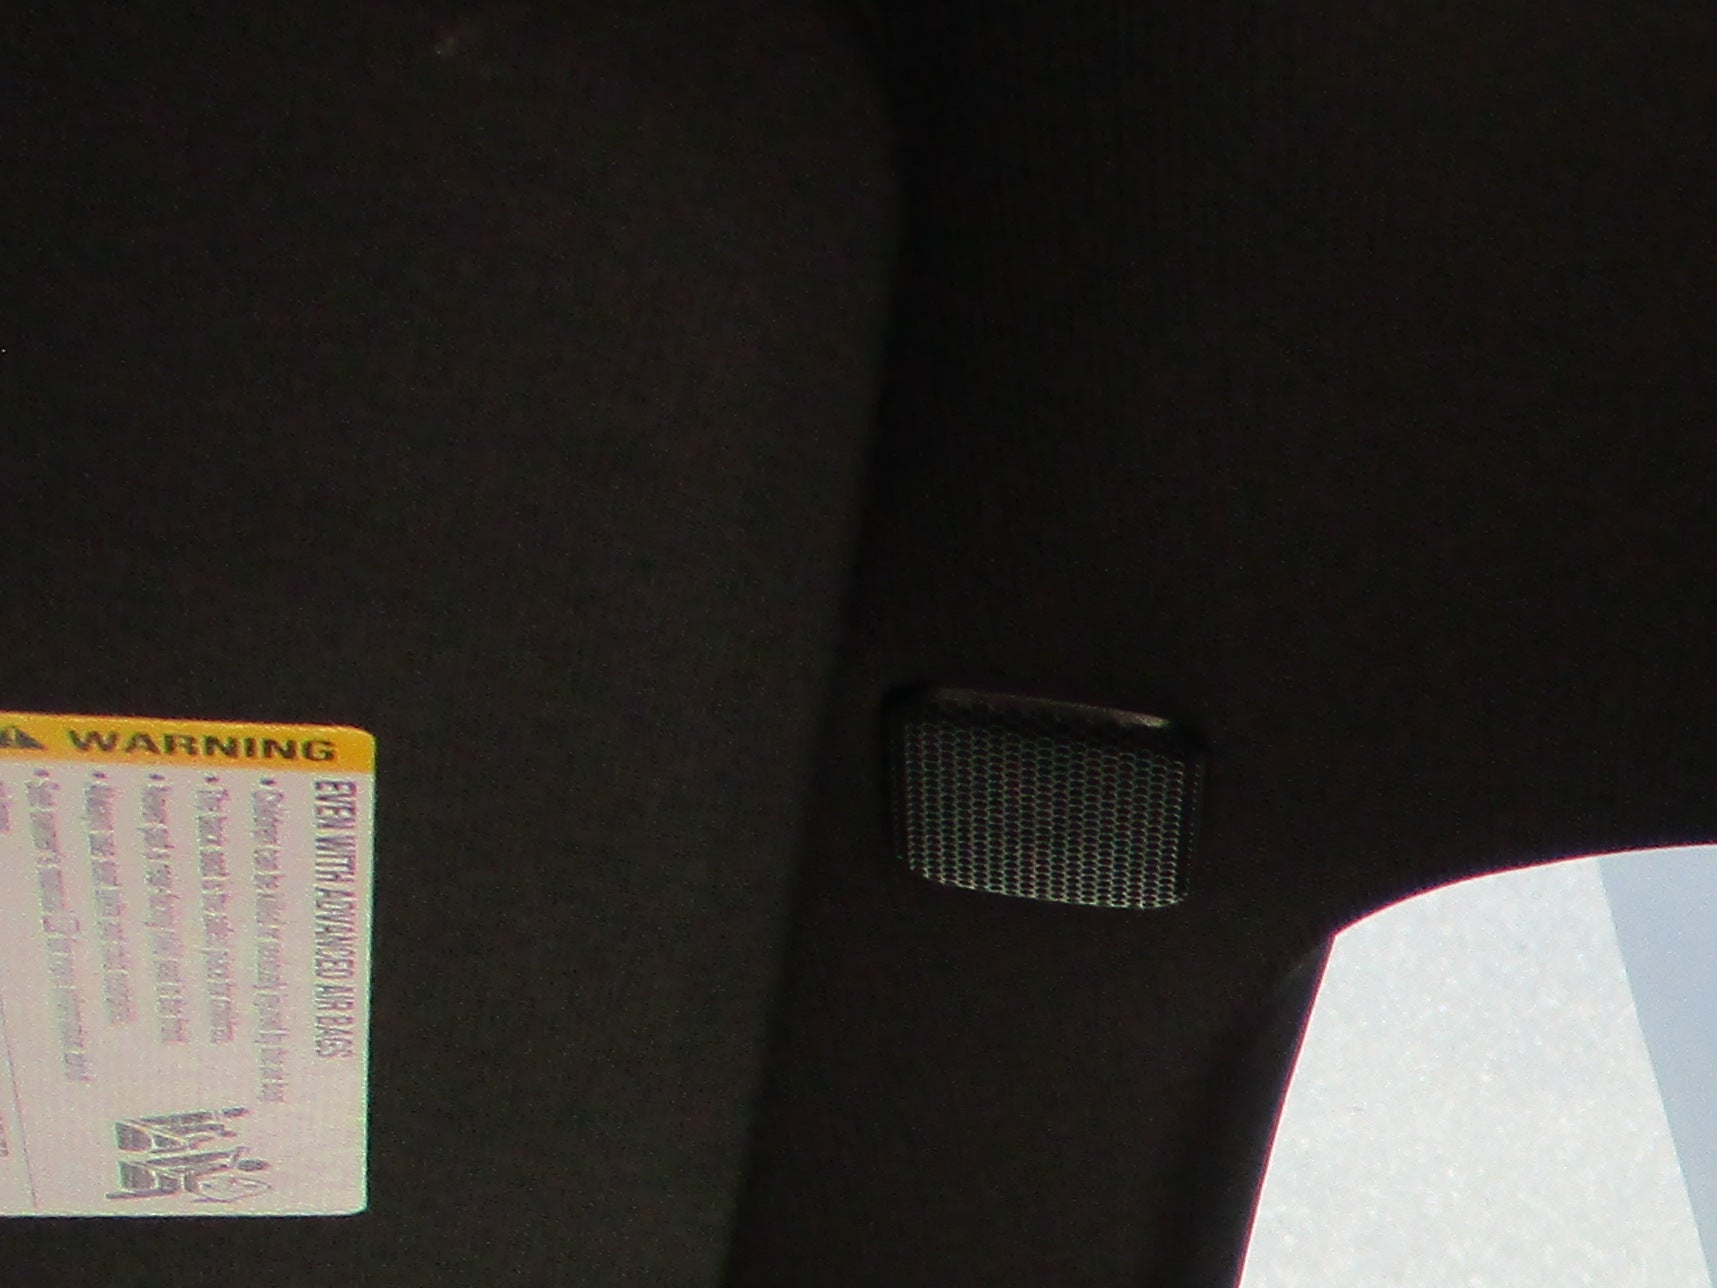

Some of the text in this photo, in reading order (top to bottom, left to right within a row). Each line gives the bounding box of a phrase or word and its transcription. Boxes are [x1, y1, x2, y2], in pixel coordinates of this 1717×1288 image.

[67, 729, 337, 762] WARNING
[314, 779, 357, 1059] EVEN WITH ADVANCED AIR BAGS
